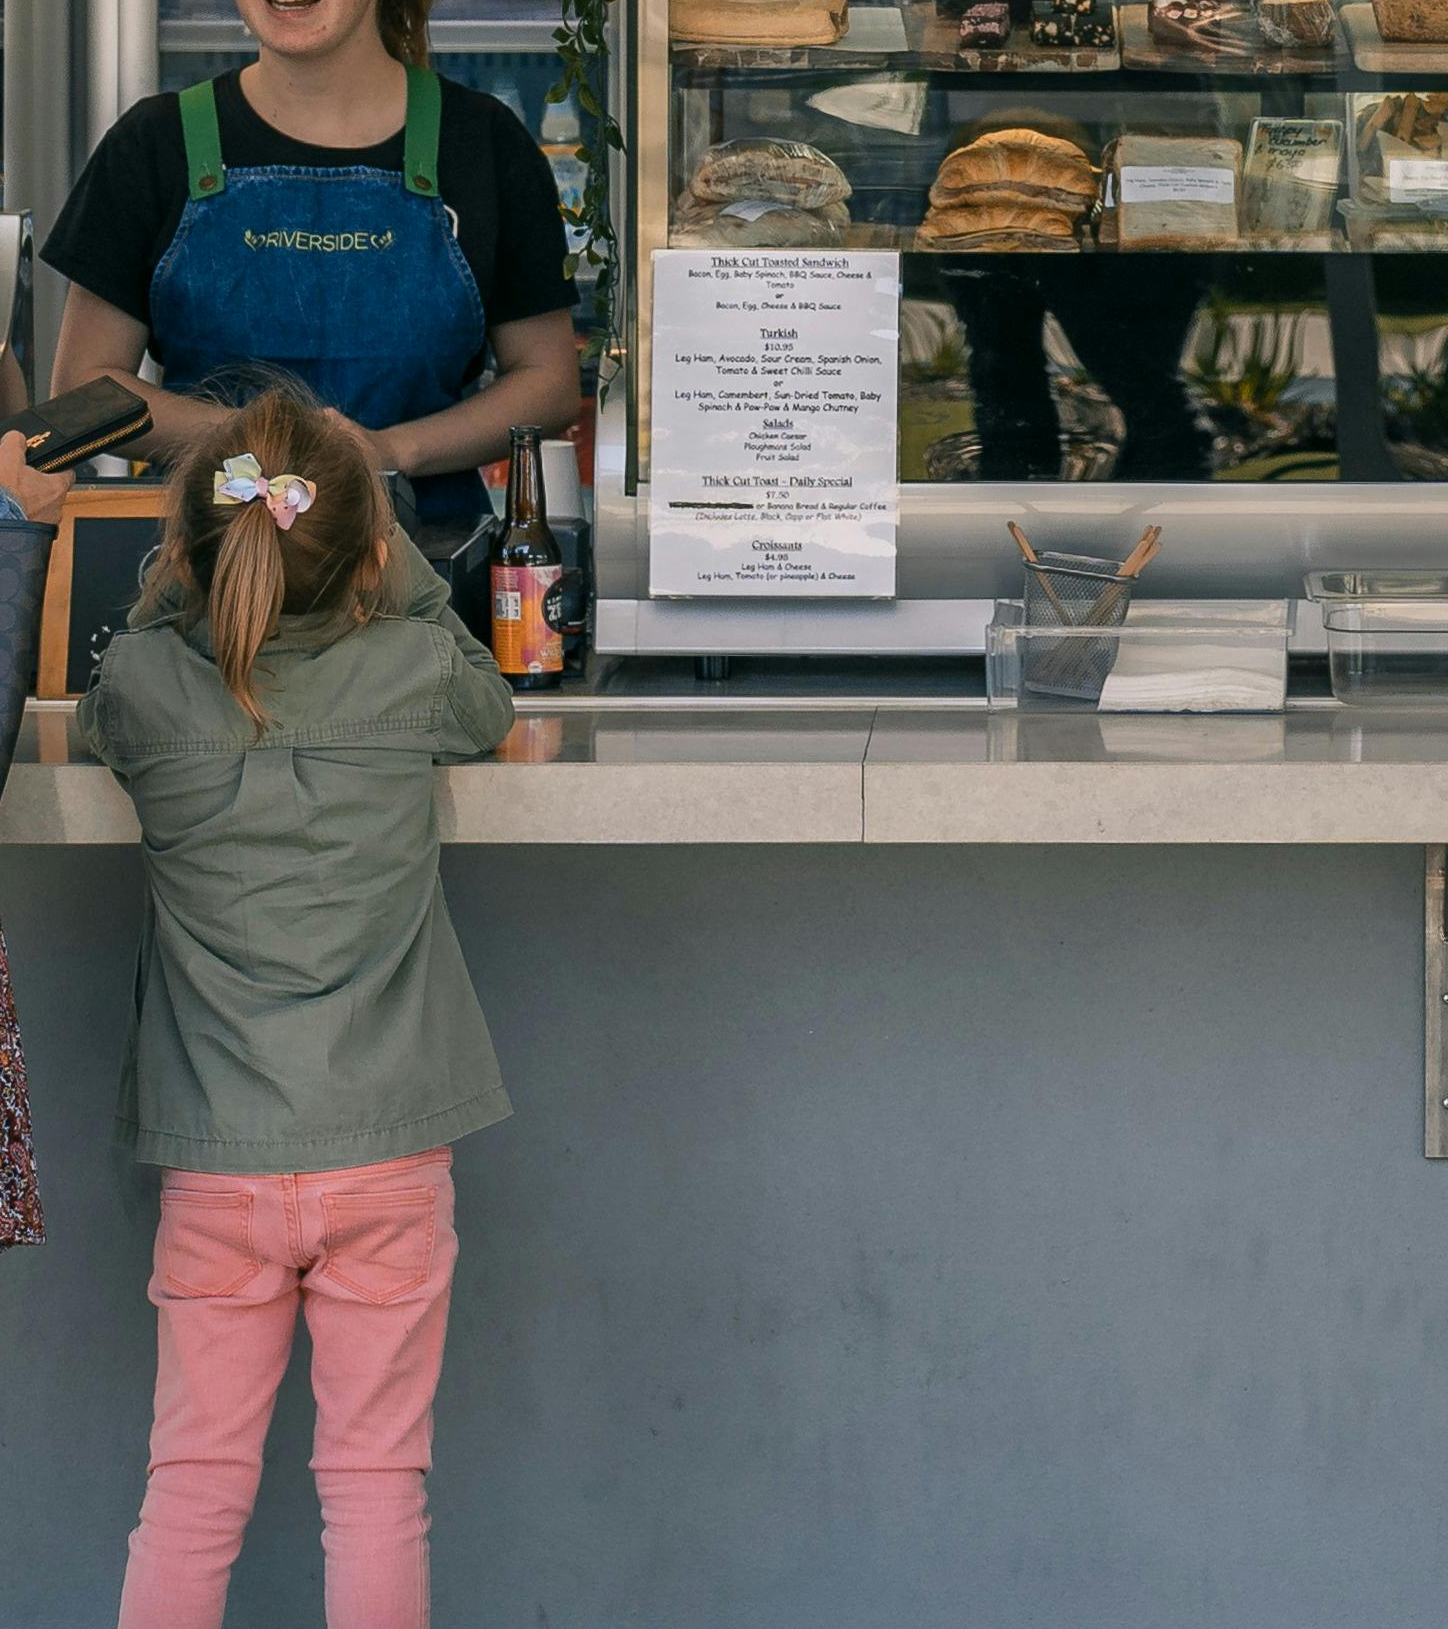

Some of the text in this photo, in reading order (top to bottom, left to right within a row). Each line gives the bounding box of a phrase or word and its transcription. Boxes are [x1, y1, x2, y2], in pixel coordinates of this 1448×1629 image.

[265, 231, 370, 251] RIVERSIDE
[711, 257, 850, 268] Thick Cut Toasted Sandwich
[836, 270, 864, 280] Cheese
[766, 281, 794, 289] Tomato
[760, 302, 788, 311] Cheese
[790, 302, 797, 311] &
[798, 302, 817, 311] BBQ
[818, 302, 841, 311] Sauce
[760, 328, 798, 339] Turkish
[764, 343, 793, 352] $10.95
[675, 354, 691, 364] Leg
[694, 354, 716, 364] Ham,
[718, 354, 758, 364] Avocado,
[760, 354, 782, 364] Sour
[817, 354, 852, 364] Spanish
[854, 354, 882, 364] Onion,
[716, 366, 842, 375] Tomato & Sweet Chilli Sauce
[674, 391, 882, 401] Leg Ham, Camembert, Sun-Dried Tomato, Baby
[698, 403, 732, 414] Spinach
[734, 403, 741, 414] &
[782, 403, 789, 414] &
[792, 403, 820, 414] Mango
[822, 403, 859, 414] Chutney
[762, 419, 794, 430] Salads
[748, 432, 779, 440] Chicken
[790, 443, 812, 452] Salad
[755, 454, 800, 462] Fruit Salad
[702, 476, 730, 487] Thick
[732, 476, 750, 487] Cut
[752, 476, 779, 487] Toast
[789, 476, 815, 487] Daily
[818, 476, 852, 487] Special
[756, 503, 887, 511] or Banana Bread & Regular Coffee
[805, 513, 814, 521] or
[834, 513, 862, 521] White)
[751, 541, 802, 551] Croissants
[742, 564, 812, 572] Leg Ham & Cheese
[697, 573, 711, 581] Leg
[736, 573, 764, 581] Tomato
[766, 573, 776, 581] (or
[779, 573, 820, 581] pineapple)
[828, 573, 856, 581] Cheese
